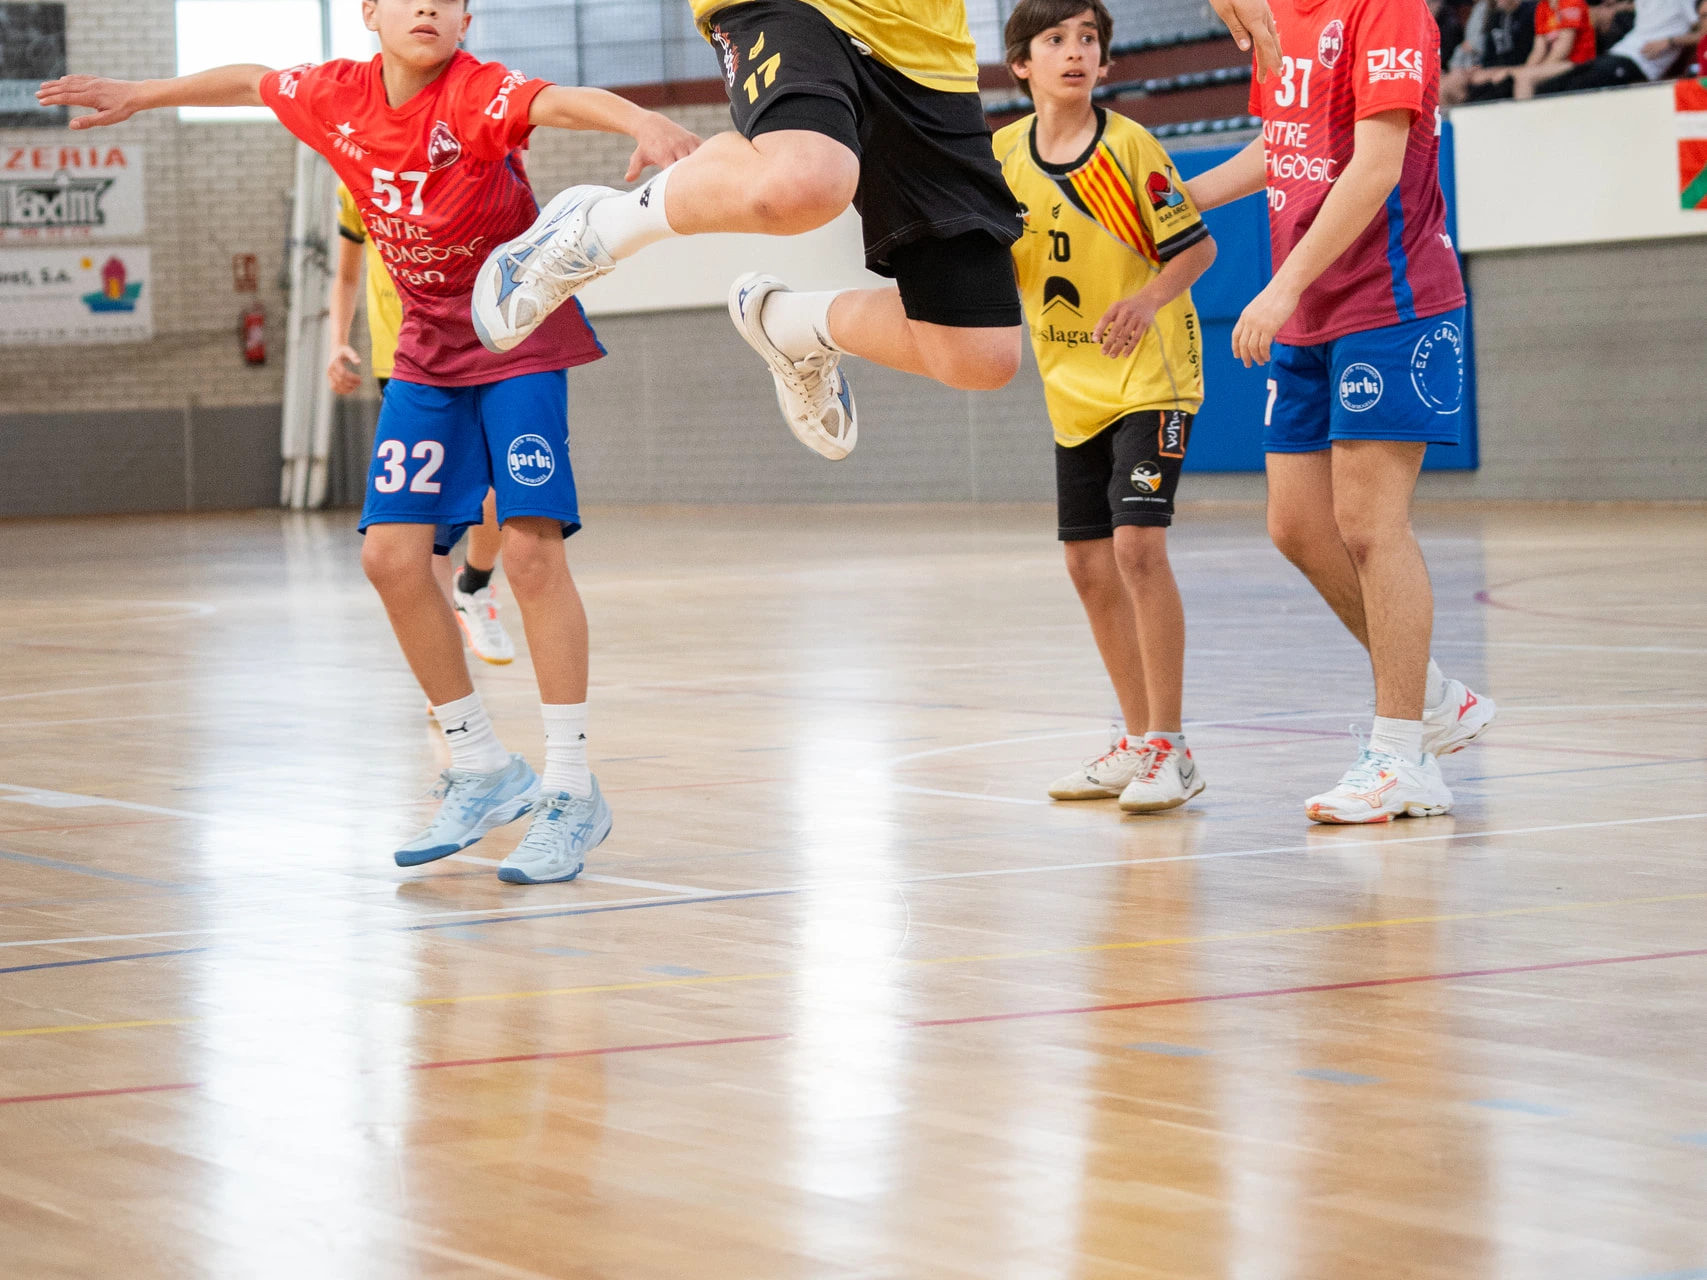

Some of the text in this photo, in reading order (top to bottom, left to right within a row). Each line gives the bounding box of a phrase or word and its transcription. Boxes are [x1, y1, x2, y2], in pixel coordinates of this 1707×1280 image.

[743, 52, 781, 104] 17
[1275, 56, 1313, 108] 37
[371, 168, 427, 215] 57
[1341, 376, 1379, 398] garbi
[375, 439, 445, 494] 32
[510, 449, 551, 471] garbi
